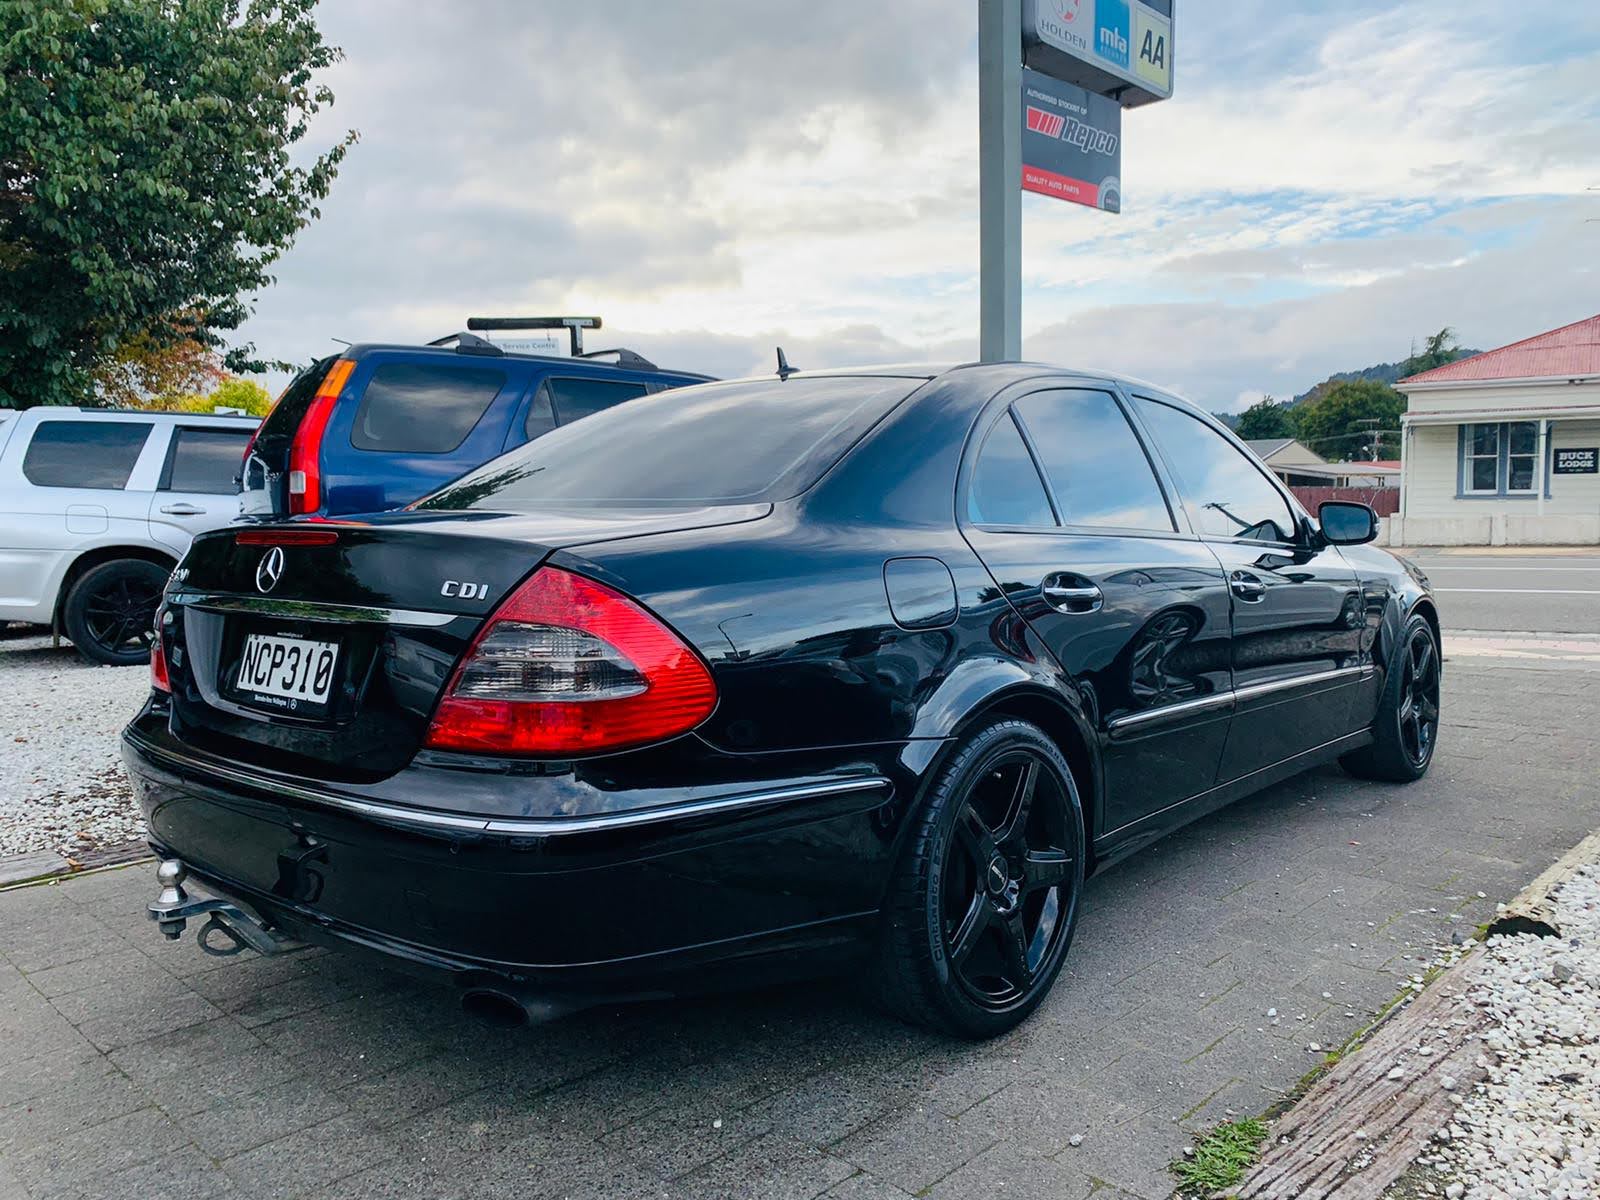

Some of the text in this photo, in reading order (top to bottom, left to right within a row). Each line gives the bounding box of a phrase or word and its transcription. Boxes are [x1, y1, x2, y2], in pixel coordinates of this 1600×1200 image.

[1040, 19, 1087, 49] HOLDEN
[1139, 28, 1164, 70] AA
[1061, 115, 1118, 156] Repco
[1025, 173, 1079, 195] QUALITY AUTO PARTS
[1558, 451, 1594, 460] BUCK
[1558, 460, 1594, 468] LODGE
[440, 580, 489, 600] CDI
[240, 640, 334, 696] NCP310
